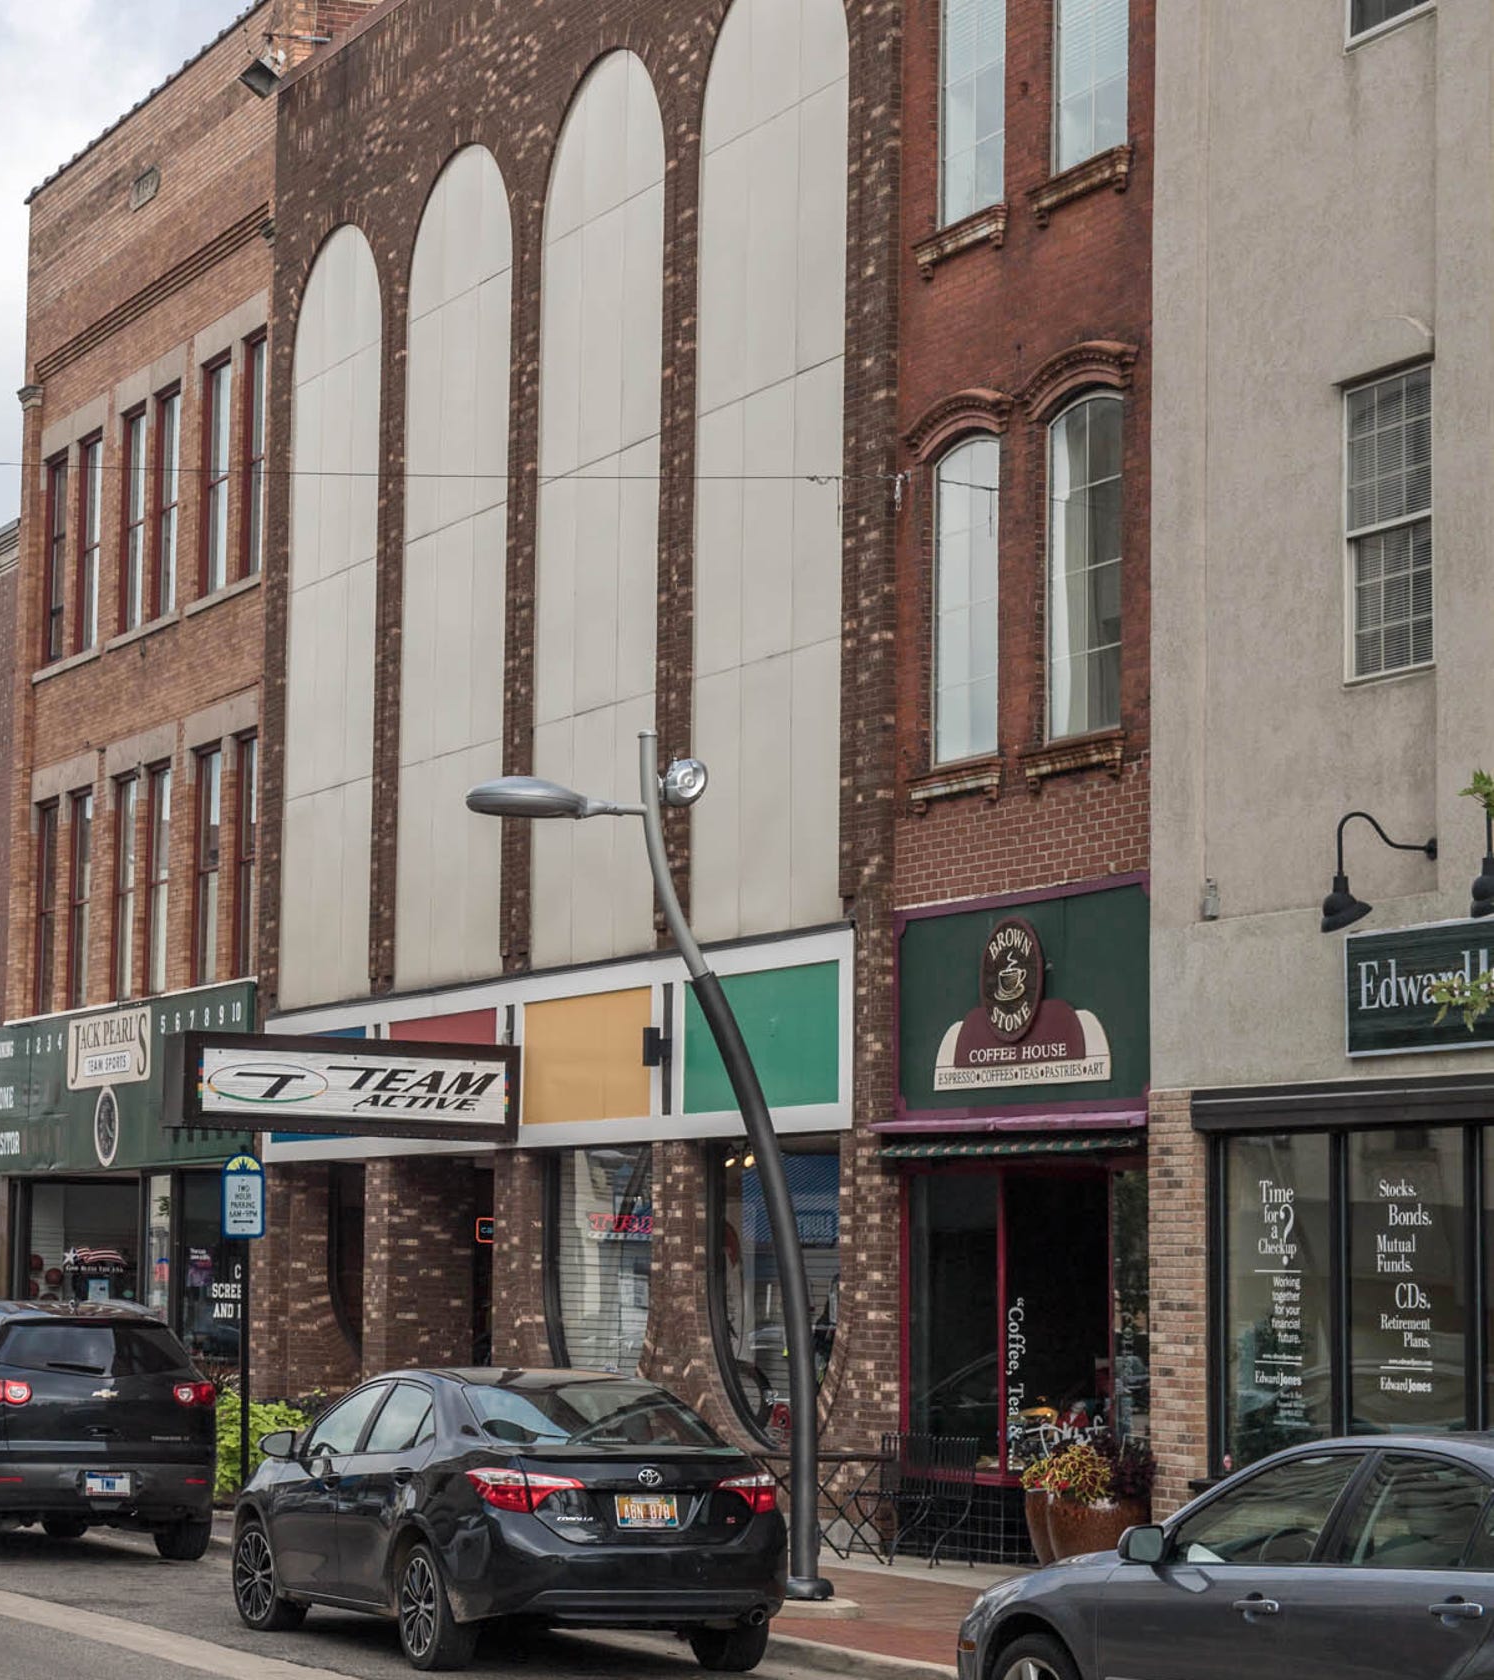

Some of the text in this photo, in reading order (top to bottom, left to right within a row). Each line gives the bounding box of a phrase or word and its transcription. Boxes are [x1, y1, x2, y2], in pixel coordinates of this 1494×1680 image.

[989, 928, 1033, 961] BROWN
[160, 1002, 241, 1034] 5 6 7 8 9 10
[990, 1001, 1031, 1032] STONE
[36, 1036, 41, 1054] 2
[46, 1035, 52, 1053] 3
[57, 1033, 63, 1050] 4
[969, 1043, 1067, 1063] COFFEE HOUSE
[86, 1055, 128, 1073] TEAM SPORTS
[938, 1061, 1105, 1085] ESPRESSO COFFEES TEAS PASTRIES ART
[326, 1065, 500, 1096] TEAM
[353, 1095, 480, 1112] ACTIVE
[1259, 1180, 1294, 1203] Time
[1379, 1179, 1417, 1197] Stocks.
[1265, 1204, 1278, 1222] for
[1389, 1203, 1432, 1226] Bonds.
[1271, 1225, 1278, 1239] a
[1258, 1238, 1297, 1259] Checkup
[1377, 1234, 1416, 1253] Mutual
[1377, 1254, 1413, 1273] Funds.
[1273, 1276, 1301, 1290] Working
[1272, 1291, 1300, 1302] together
[1395, 1282, 1431, 1309] CDs.
[213, 1304, 234, 1319] AND
[1275, 1303, 1301, 1317] for your
[1272, 1318, 1301, 1329] financial
[1380, 1313, 1430, 1331] Retirement
[1277, 1332, 1301, 1344] future.
[1403, 1331, 1431, 1348] Plans.
[1008, 1383, 1024, 1416] Tea
[1008, 1425, 1023, 1440] &
